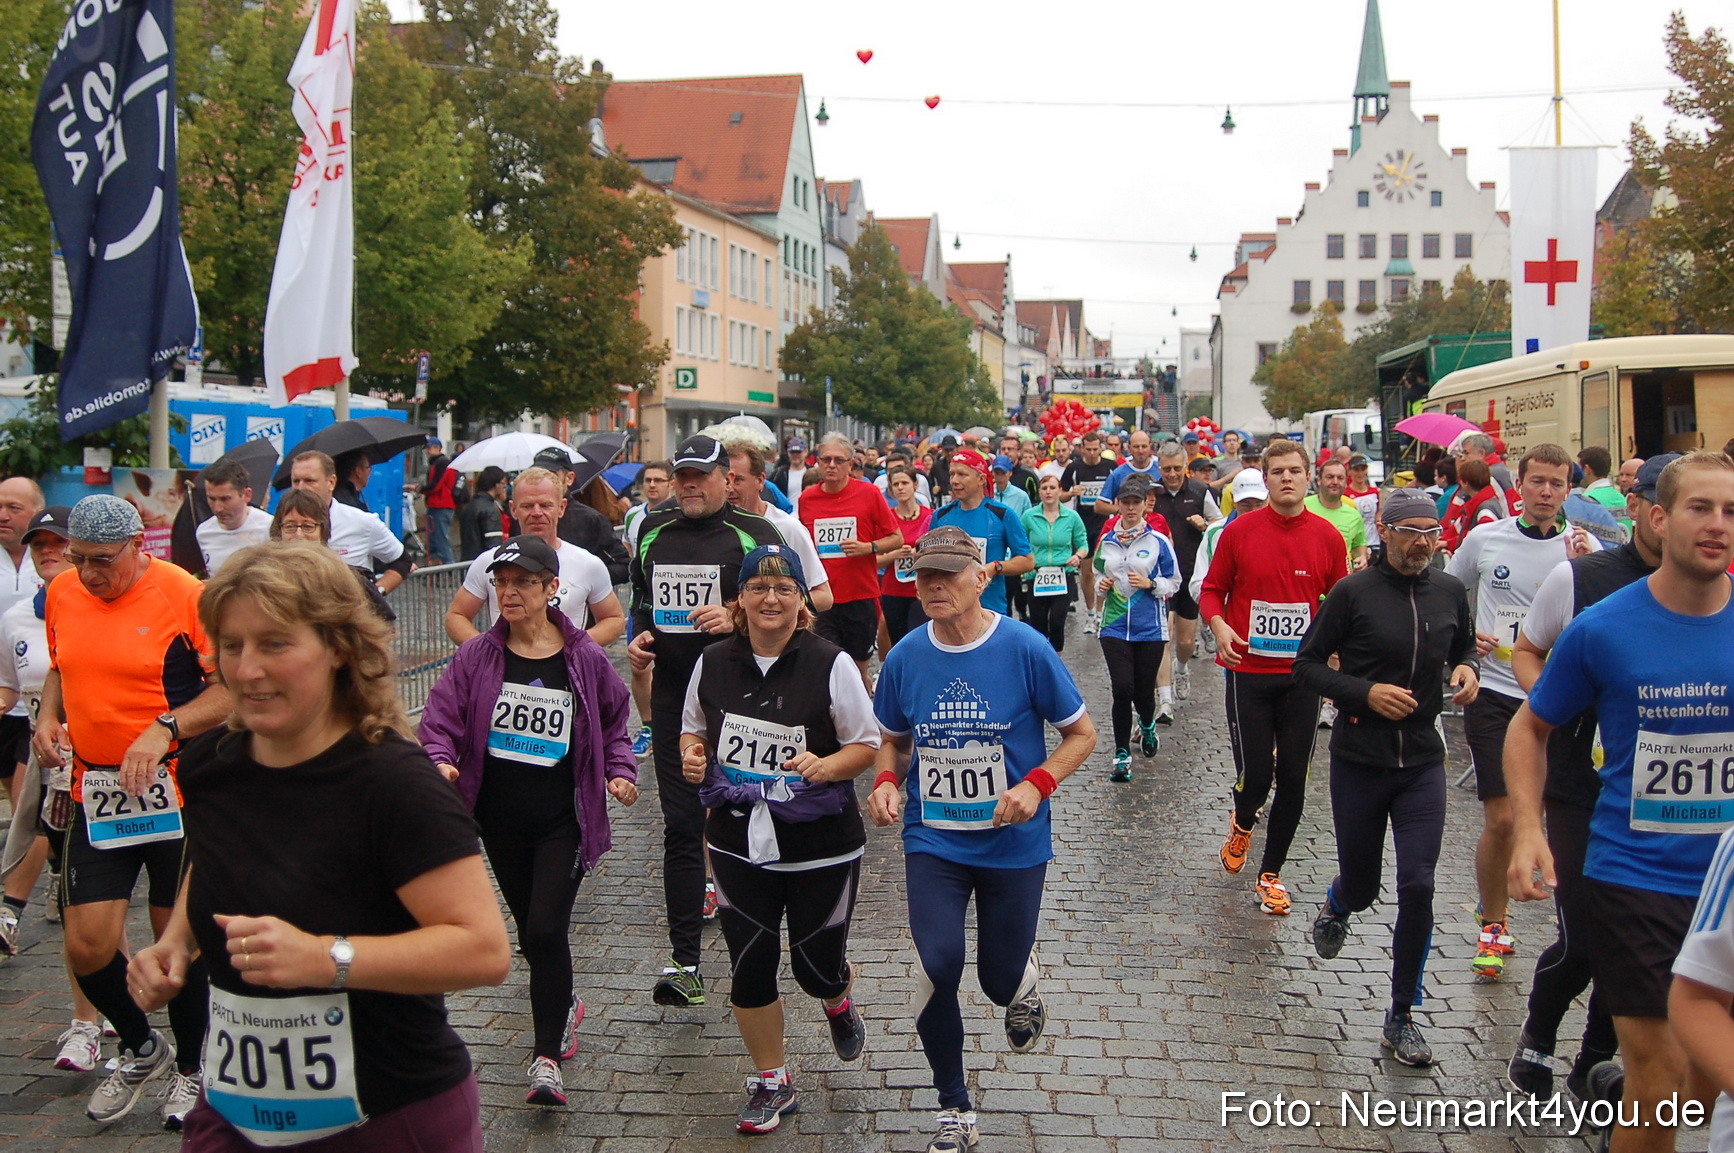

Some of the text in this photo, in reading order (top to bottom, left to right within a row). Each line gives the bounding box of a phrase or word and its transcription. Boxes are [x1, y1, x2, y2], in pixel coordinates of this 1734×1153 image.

[678, 370, 694, 387] D
[1082, 395, 1113, 404] START
[1505, 391, 1555, 416] Bayerisches
[1504, 419, 1528, 437] Rotes
[1083, 486, 1103, 497] 252
[818, 527, 852, 543] 2877
[899, 556, 914, 570] 23
[654, 571, 707, 579] PARTL Neumarkt
[1037, 573, 1062, 585] 2621
[659, 581, 713, 607] 3157
[1497, 610, 1519, 618] PARTL
[1255, 615, 1305, 636] 3032
[1263, 640, 1294, 650] Michael
[1638, 681, 1727, 699] Kirwaläufer
[520, 693, 560, 705] Neumarkt
[1638, 702, 1729, 719] Pettenhofen
[494, 701, 565, 738] 2689
[724, 721, 792, 742] PARTL Neumarkt
[915, 721, 1011, 738] 13. Neumarkter Stadtlauf
[505, 736, 546, 754] Marlies
[726, 735, 797, 772] 2143
[1639, 742, 1733, 754] PARTL Neumarkt
[920, 754, 988, 765] PARTL Neumarkt
[84, 779, 111, 787] PARTL
[927, 766, 995, 799] 2101
[943, 806, 984, 819] Helmar
[1661, 805, 1721, 819] Michael
[116, 819, 156, 835] Robert
[212, 1001, 318, 1029] PARTL Neumarkt
[217, 1028, 337, 1092] 2015
[253, 1104, 297, 1130] Inge
